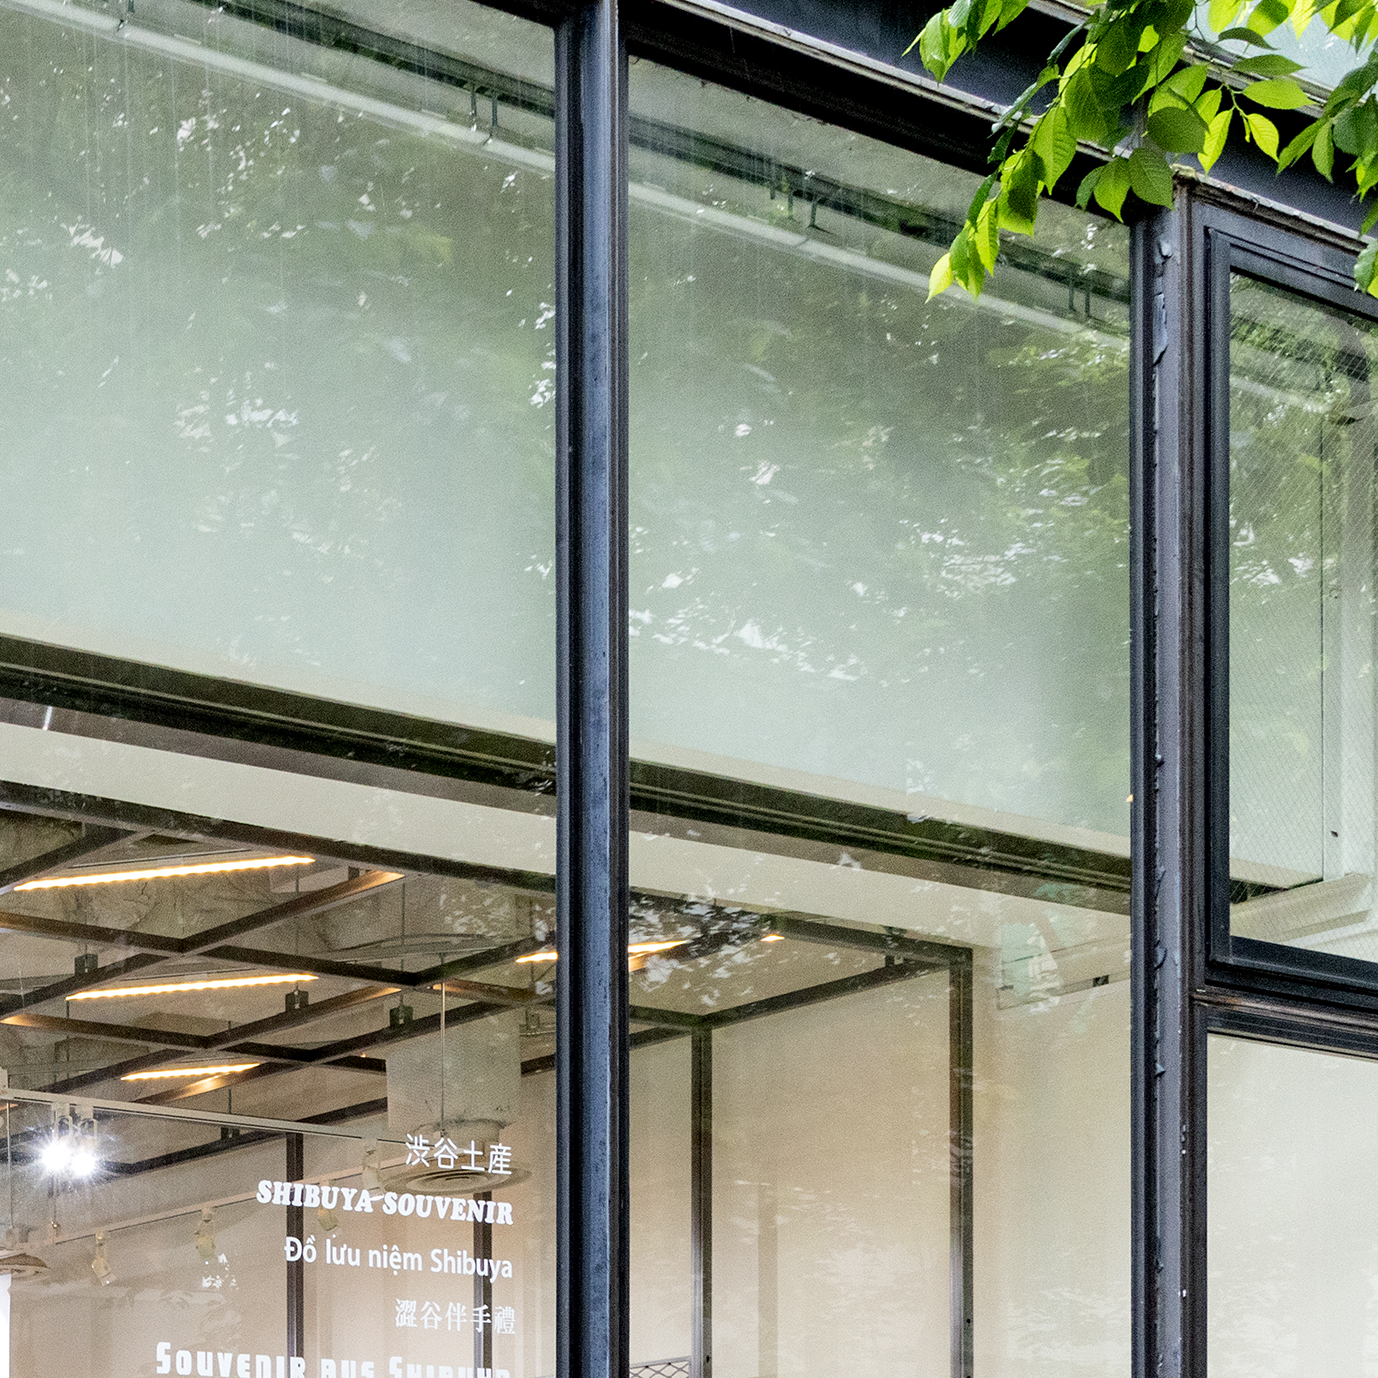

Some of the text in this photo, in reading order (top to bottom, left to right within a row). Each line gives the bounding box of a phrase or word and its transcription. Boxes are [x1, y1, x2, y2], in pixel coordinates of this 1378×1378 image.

[404, 1132, 513, 1176] 渋谷土産
[256, 1180, 514, 1226] SHIBUYA SOUVENIR
[284, 1236, 513, 1284] Đồ lưu niệm Shibuya
